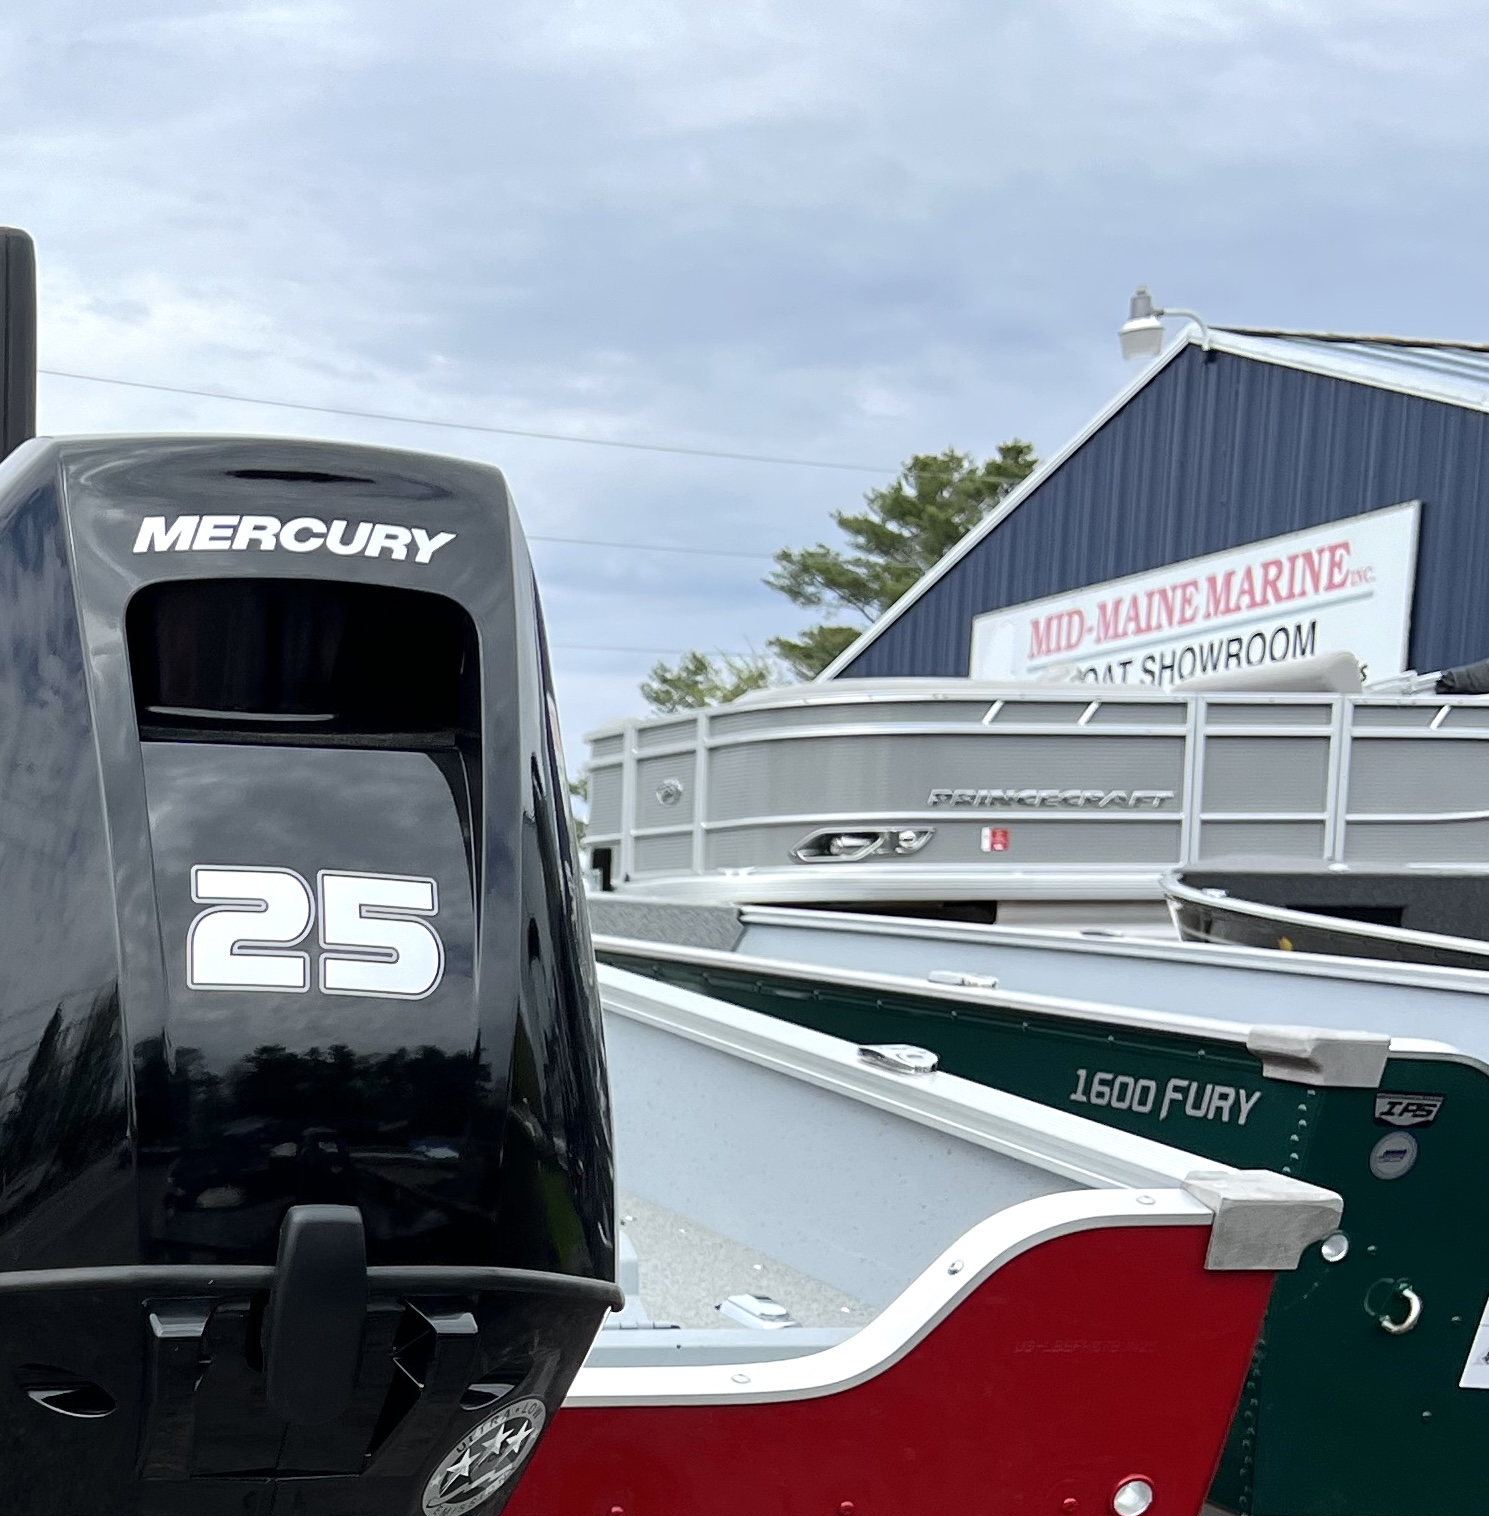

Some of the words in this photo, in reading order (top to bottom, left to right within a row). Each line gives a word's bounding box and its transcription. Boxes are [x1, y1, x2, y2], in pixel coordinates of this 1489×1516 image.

[132, 514, 457, 565] MERCURY
[1027, 578, 1199, 660] MID-MAINE
[1202, 540, 1351, 620] MARINE
[1140, 619, 1318, 690] SHOWROOM
[926, 787, 1175, 808] PRINCECRAFT
[185, 863, 446, 1001] 25
[1068, 1067, 1155, 1115] 1600
[1158, 1076, 1263, 1126] FURY
[1379, 1100, 1437, 1118] IPS
